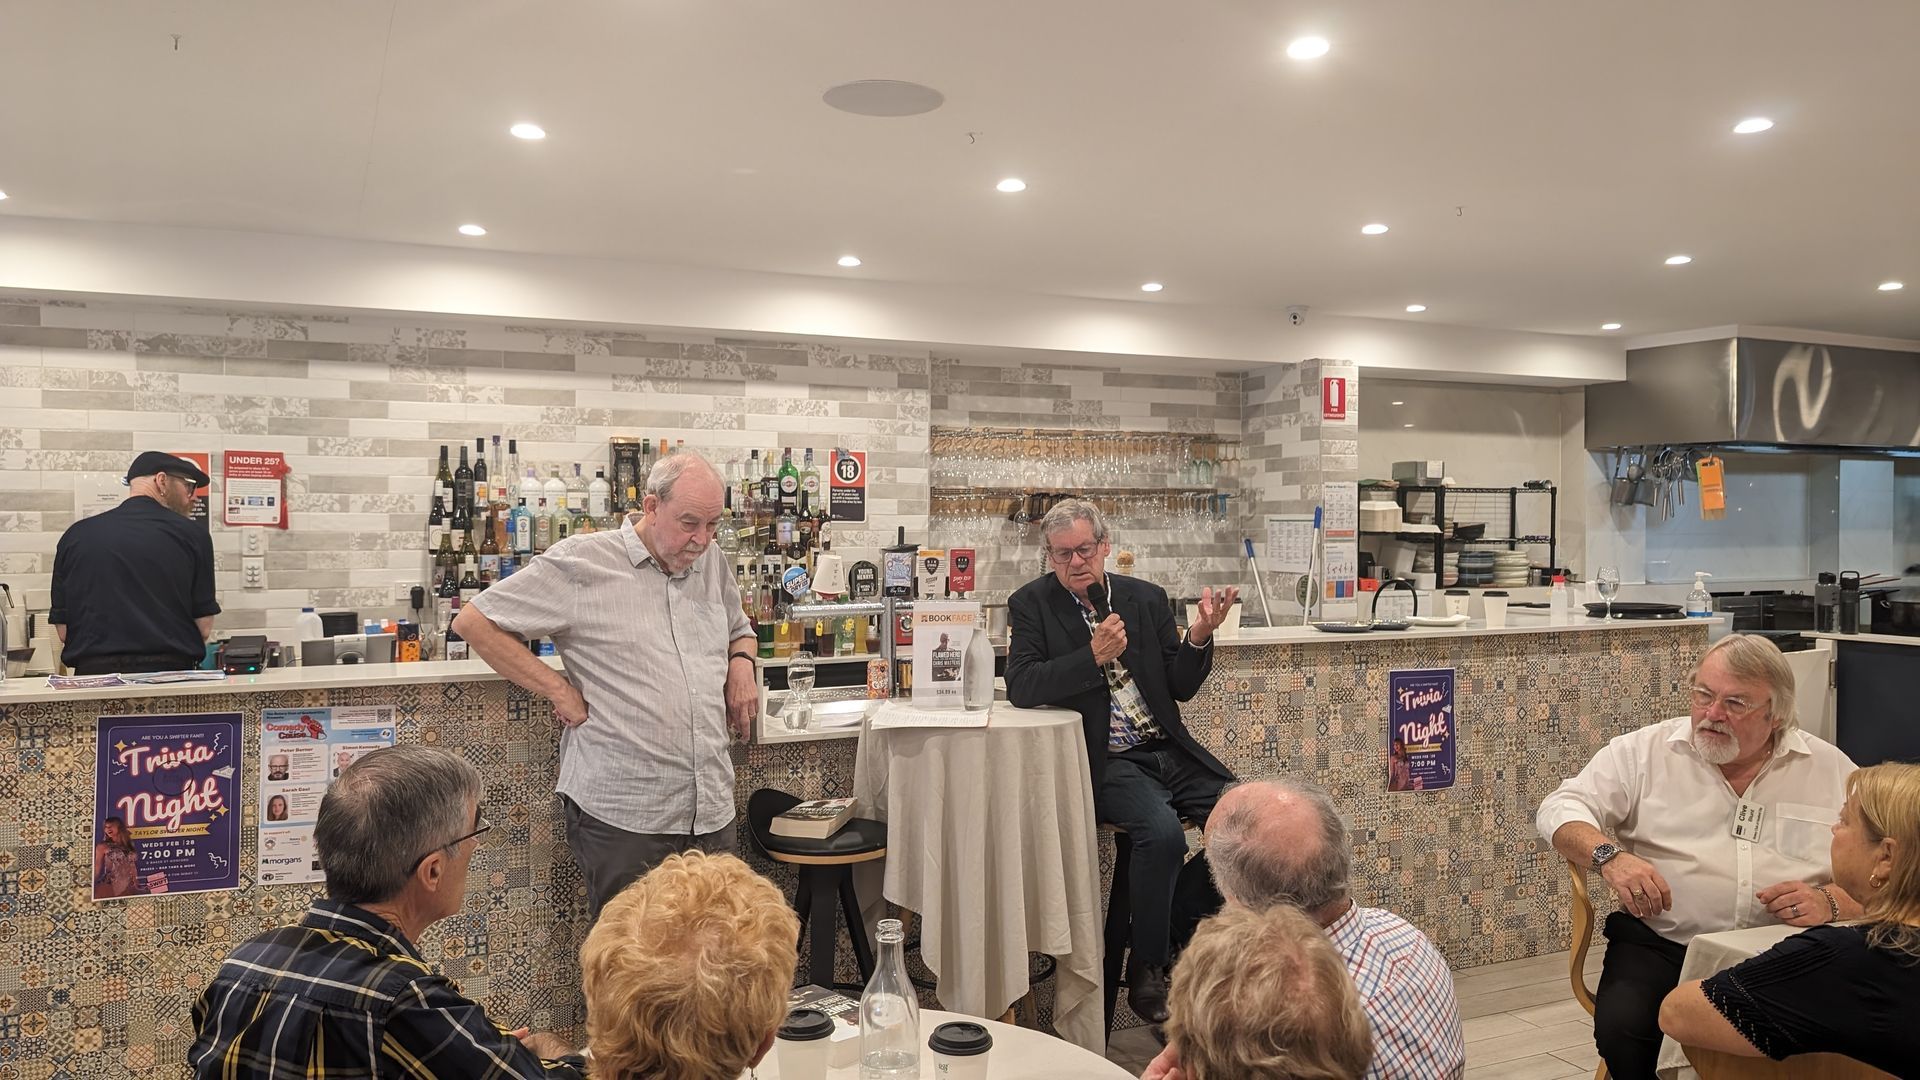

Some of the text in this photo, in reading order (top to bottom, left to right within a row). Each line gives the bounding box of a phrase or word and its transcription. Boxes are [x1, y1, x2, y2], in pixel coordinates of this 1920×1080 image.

[229, 456, 262, 465] UNDER
[840, 465, 855, 479] 18
[786, 574, 807, 589] SUPER
[791, 583, 802, 593] DRY
[1400, 688, 1442, 711] Trivia
[266, 722, 306, 732] Comedy
[1400, 712, 1447, 748] Night
[278, 731, 306, 740] Cause
[120, 742, 214, 776] Trivia
[118, 777, 223, 831] Night
[1739, 805, 1748, 822] Clive
[141, 849, 195, 860] 7:00 PM
[270, 857, 302, 865] morgans
[149, 879, 167, 888] SWIFT
